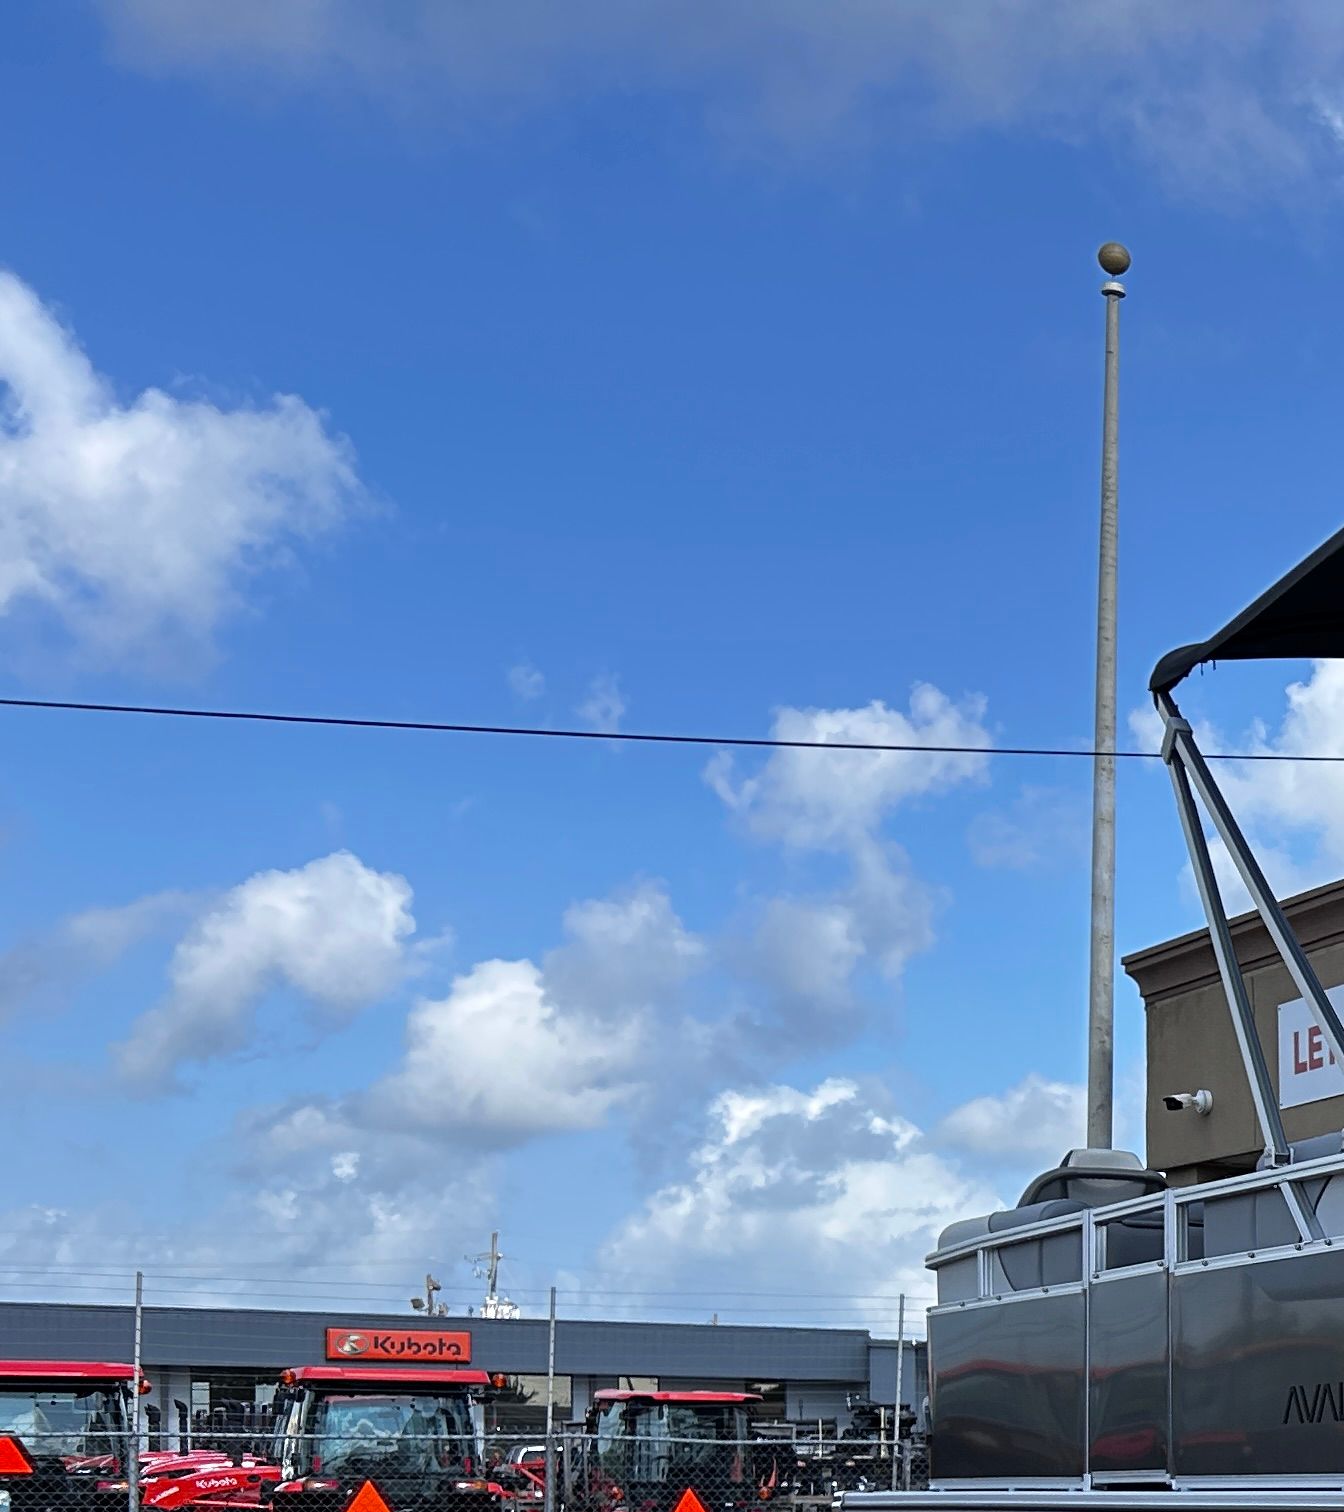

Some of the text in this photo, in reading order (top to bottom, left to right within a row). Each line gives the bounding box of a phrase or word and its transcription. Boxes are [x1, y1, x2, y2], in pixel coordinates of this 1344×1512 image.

[1293, 1022, 1338, 1075] LE
[373, 1335, 462, 1356] Kubota
[196, 1476, 238, 1489] Kubota
